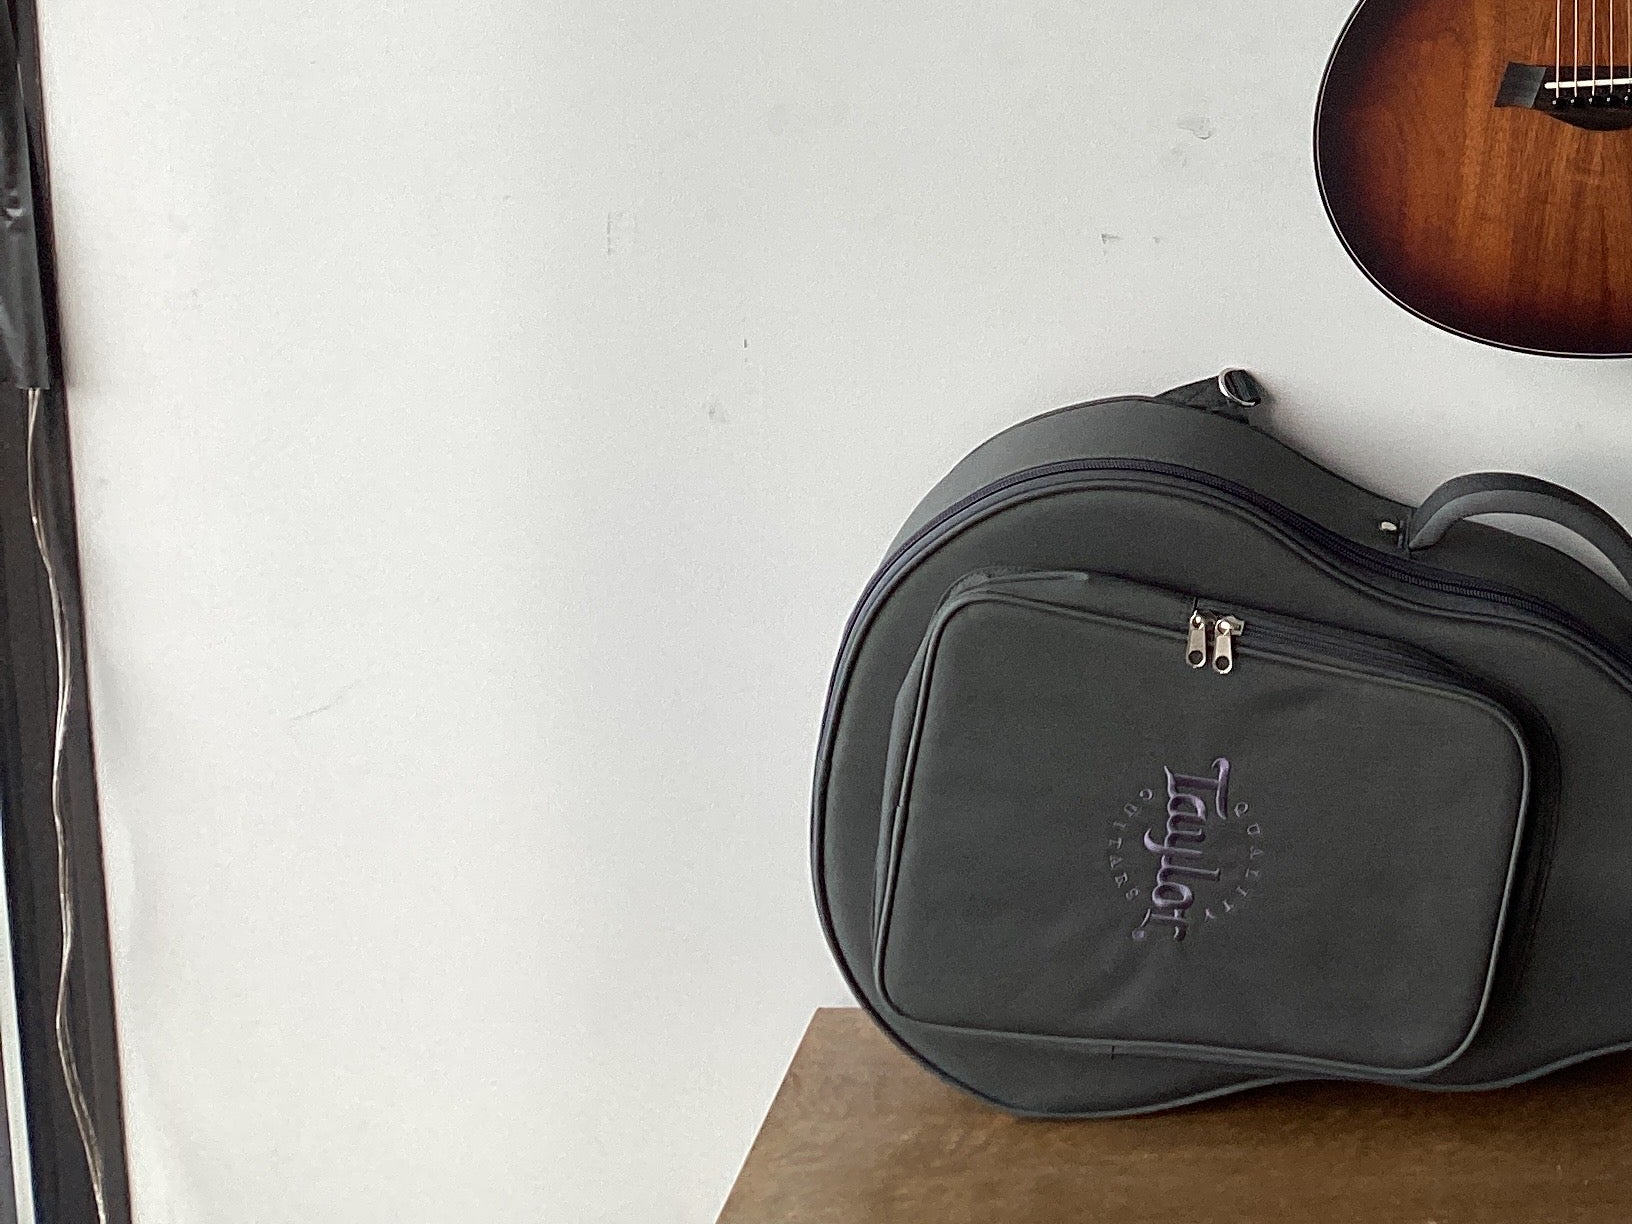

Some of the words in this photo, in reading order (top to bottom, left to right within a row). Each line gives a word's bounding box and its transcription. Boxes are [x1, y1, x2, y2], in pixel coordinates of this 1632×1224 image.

[1109, 788, 1153, 901] GUITARS
[1132, 757, 1230, 941] Taylor
[1205, 800, 1263, 921] QUALITY
